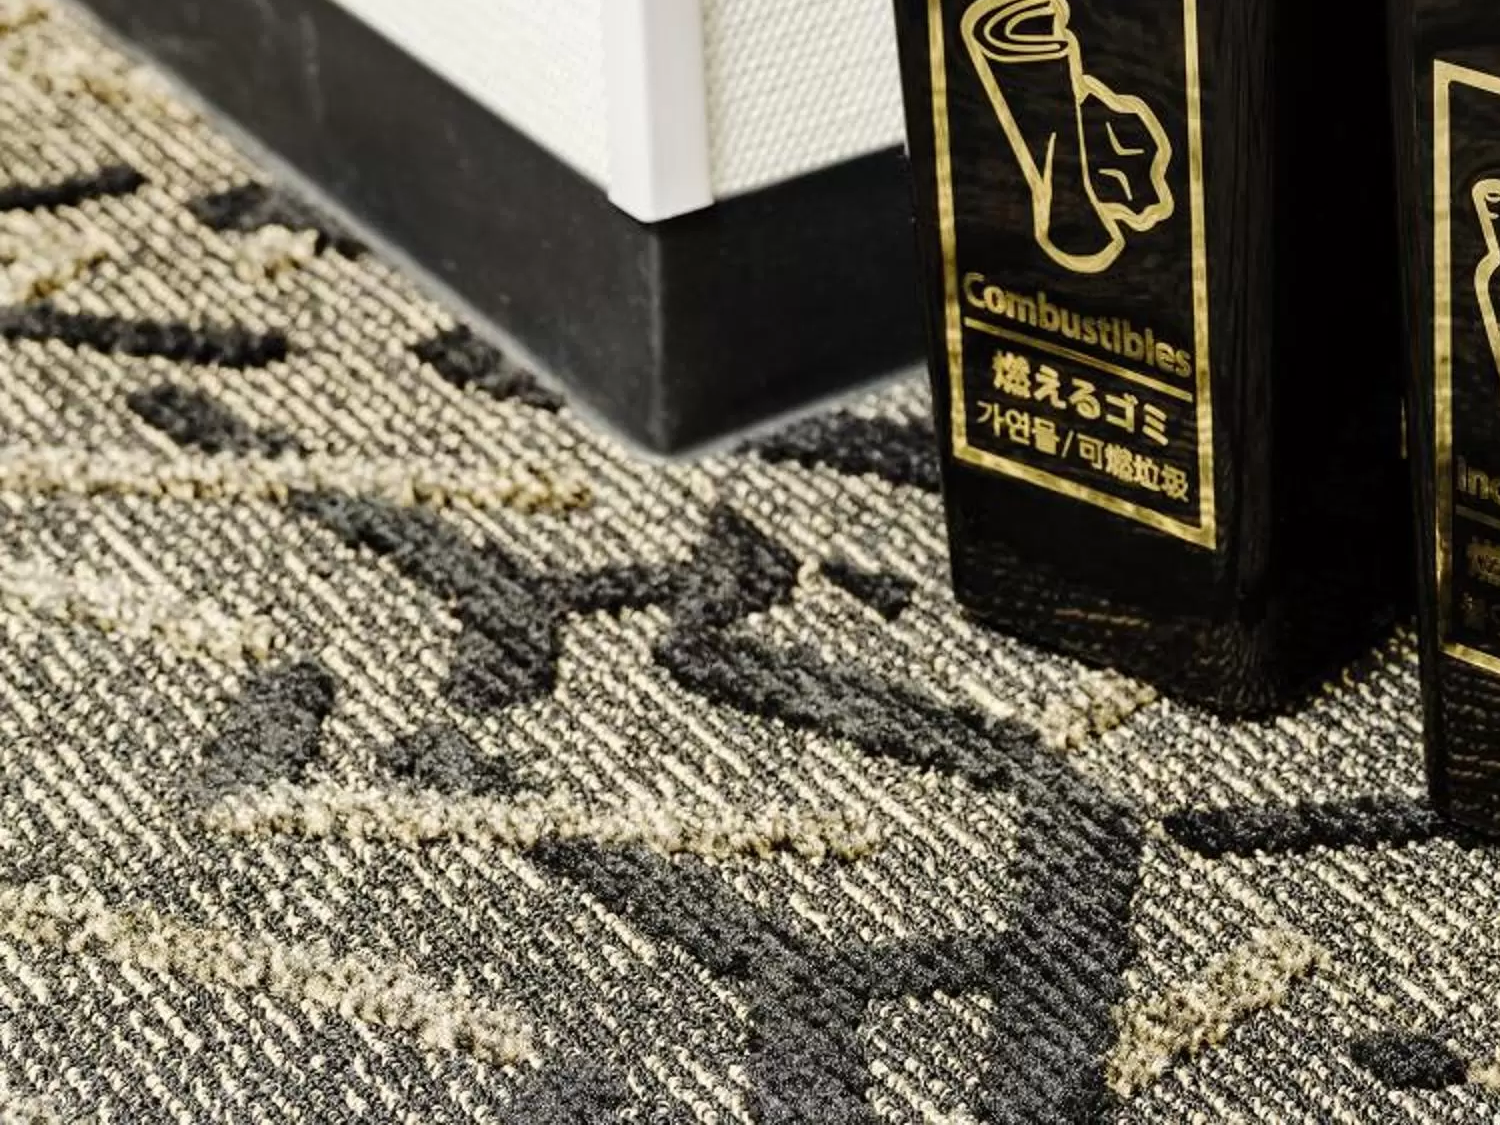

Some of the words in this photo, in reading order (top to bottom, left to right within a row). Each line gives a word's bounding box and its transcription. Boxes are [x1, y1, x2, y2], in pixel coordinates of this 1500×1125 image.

[964, 272, 1193, 377] Combustibles
[992, 349, 1169, 446] 燃えるゴミ
